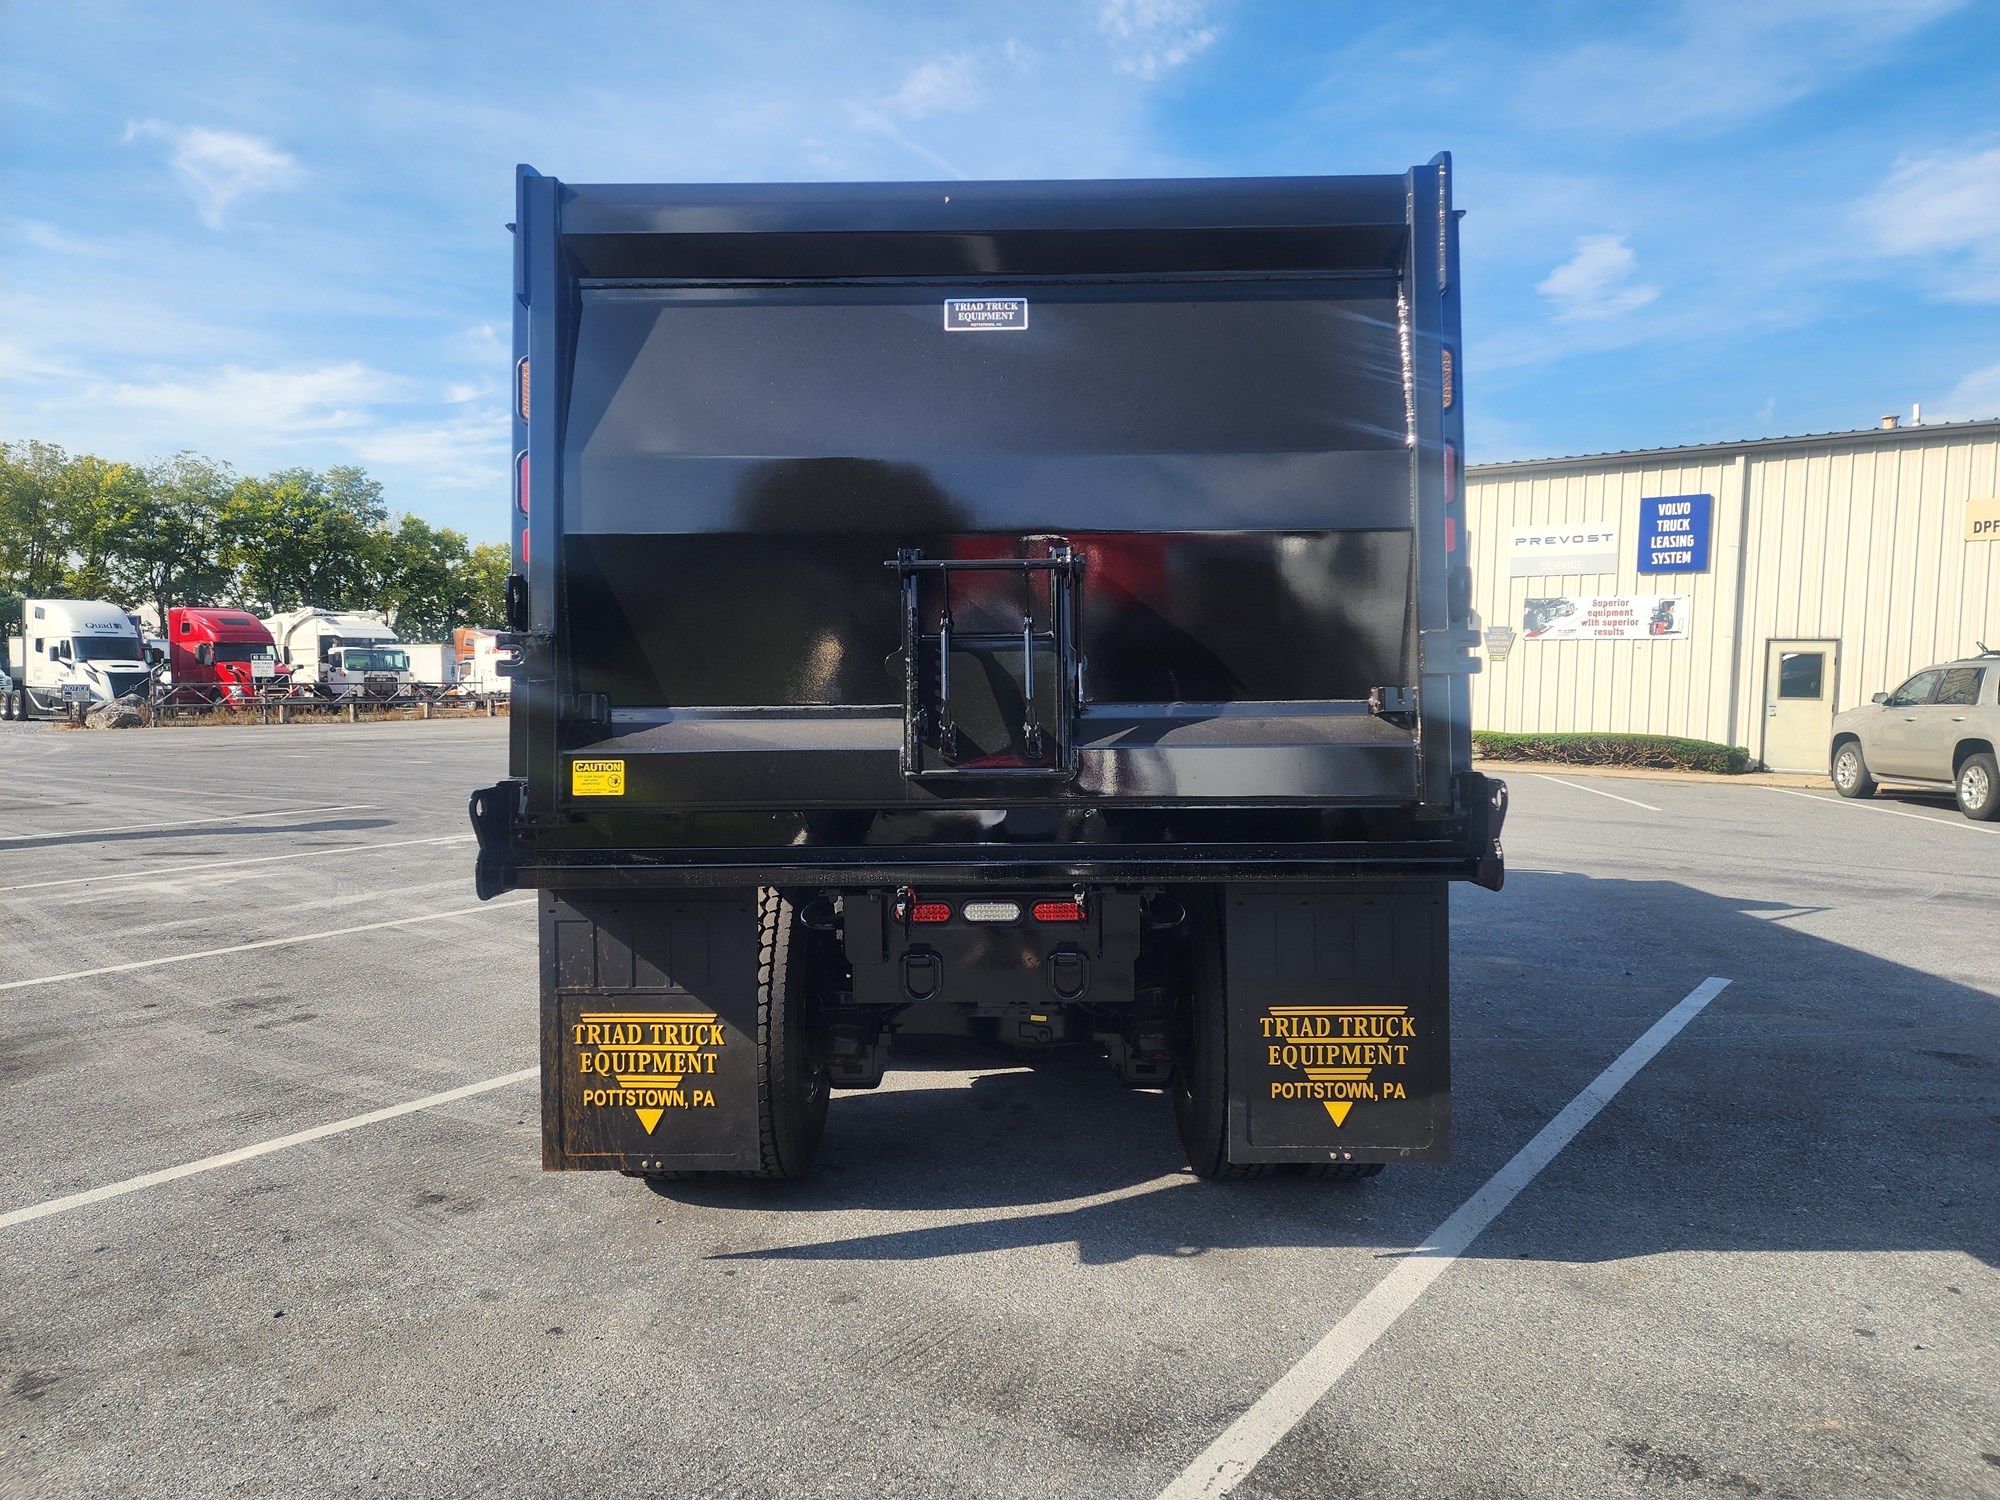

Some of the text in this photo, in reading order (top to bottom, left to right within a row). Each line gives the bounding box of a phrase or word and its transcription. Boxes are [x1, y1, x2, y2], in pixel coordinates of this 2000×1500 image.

[954, 302, 1018, 312] TRIAD TRUCK
[958, 312, 1014, 321] EQUIPMENT
[1658, 502, 1691, 516] VOLVO
[1657, 518, 1691, 532] TRUCK
[1974, 520, 2000, 533] DPF
[1515, 533, 1614, 546] PREVOST
[1650, 534, 1695, 549] LEASING
[1651, 551, 1692, 565] SYSTEM
[1541, 560, 1584, 571] SERVICE
[1592, 599, 1630, 609] Superior
[1587, 608, 1634, 618] equipment
[85, 622, 113, 630] Quad
[1581, 618, 1639, 628] with superior
[1594, 627, 1625, 636] results
[576, 763, 620, 772] CAUTION
[1259, 1017, 1416, 1038] TRIAD TRUCK
[572, 1024, 725, 1046] TRIAD TRUCK
[1268, 1045, 1409, 1069] EQUIPMENT
[580, 1052, 718, 1077] EQUIPMENT
[1271, 1082, 1407, 1102] POTTSTOWN, PA
[583, 1089, 716, 1109] POTTSTOWN, PA
